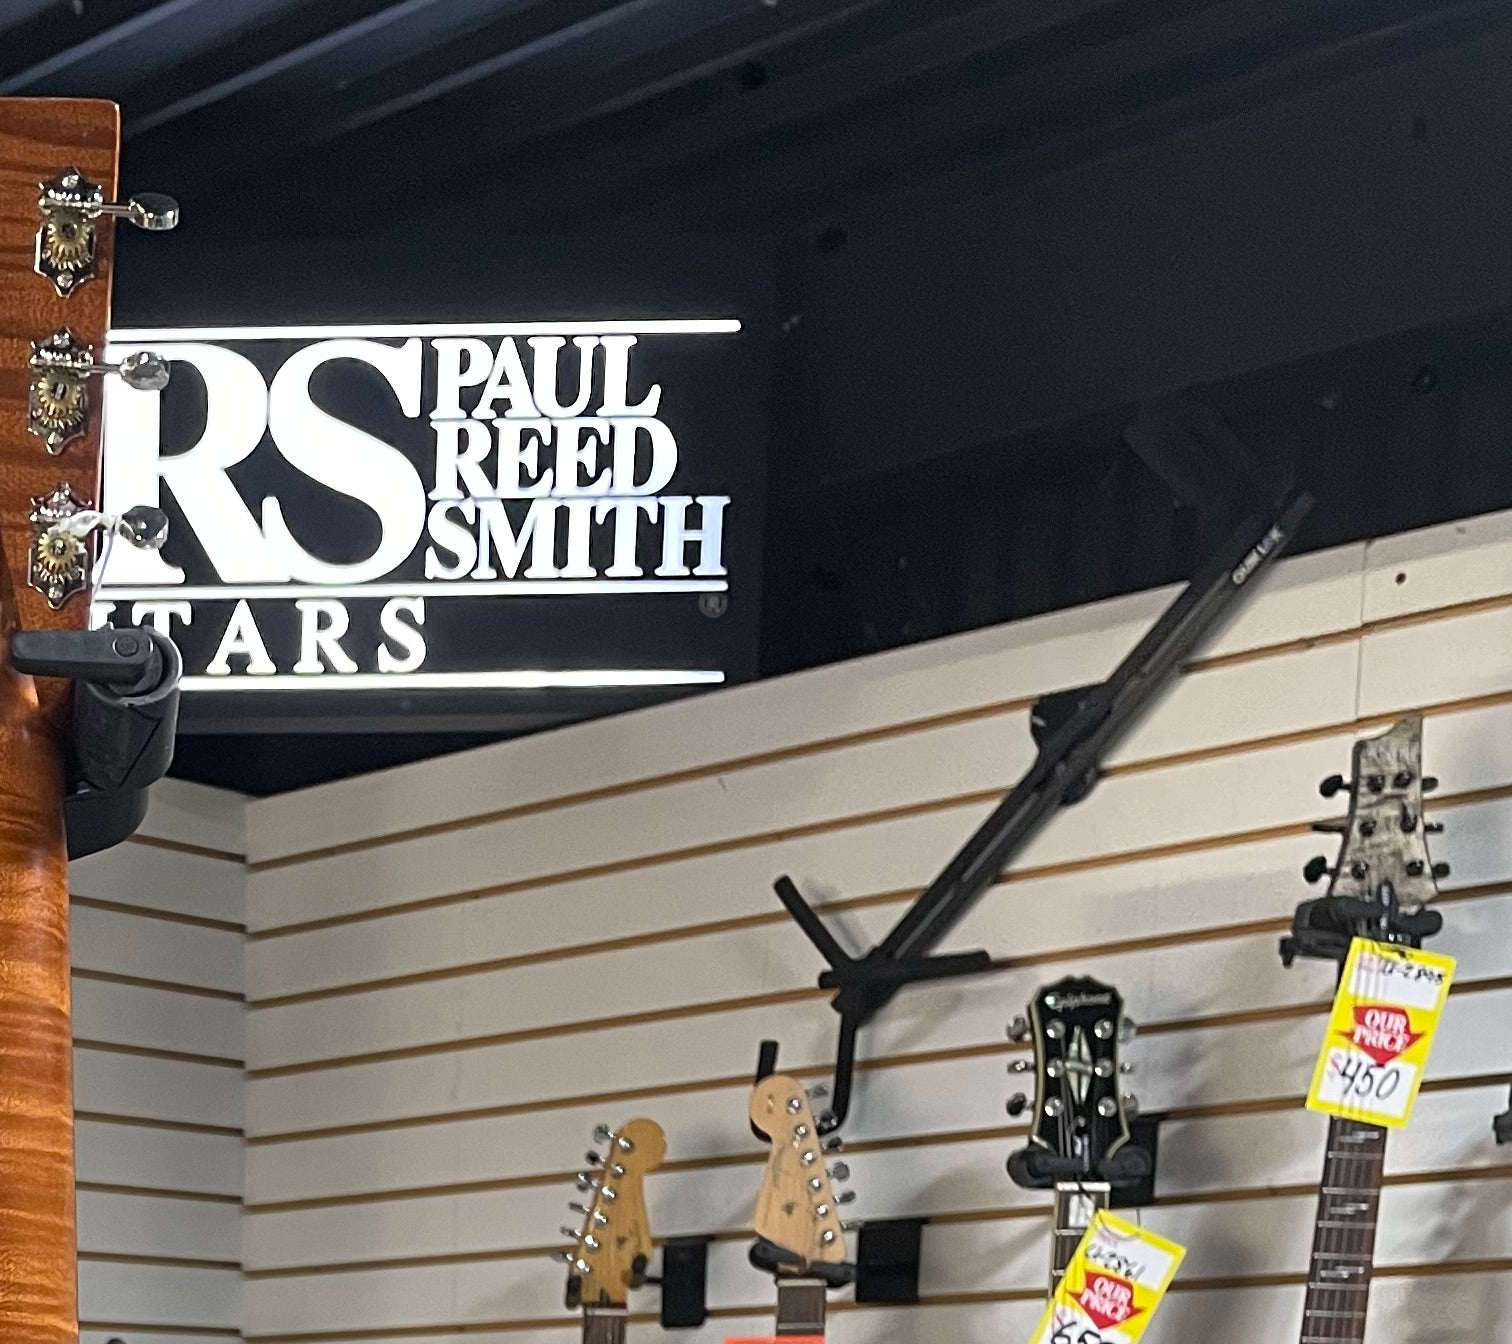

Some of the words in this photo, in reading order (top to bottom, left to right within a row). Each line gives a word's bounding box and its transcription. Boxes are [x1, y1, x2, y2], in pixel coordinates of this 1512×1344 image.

[430, 334, 662, 419] PAUL
[91, 337, 428, 585] RS
[429, 417, 679, 501] REED
[425, 496, 731, 580] SMITH
[91, 598, 427, 676] TARS
[1352, 1023, 1411, 1053] PRICE
[1364, 1008, 1408, 1035] OUR
[1092, 1276, 1133, 1300] OUR
